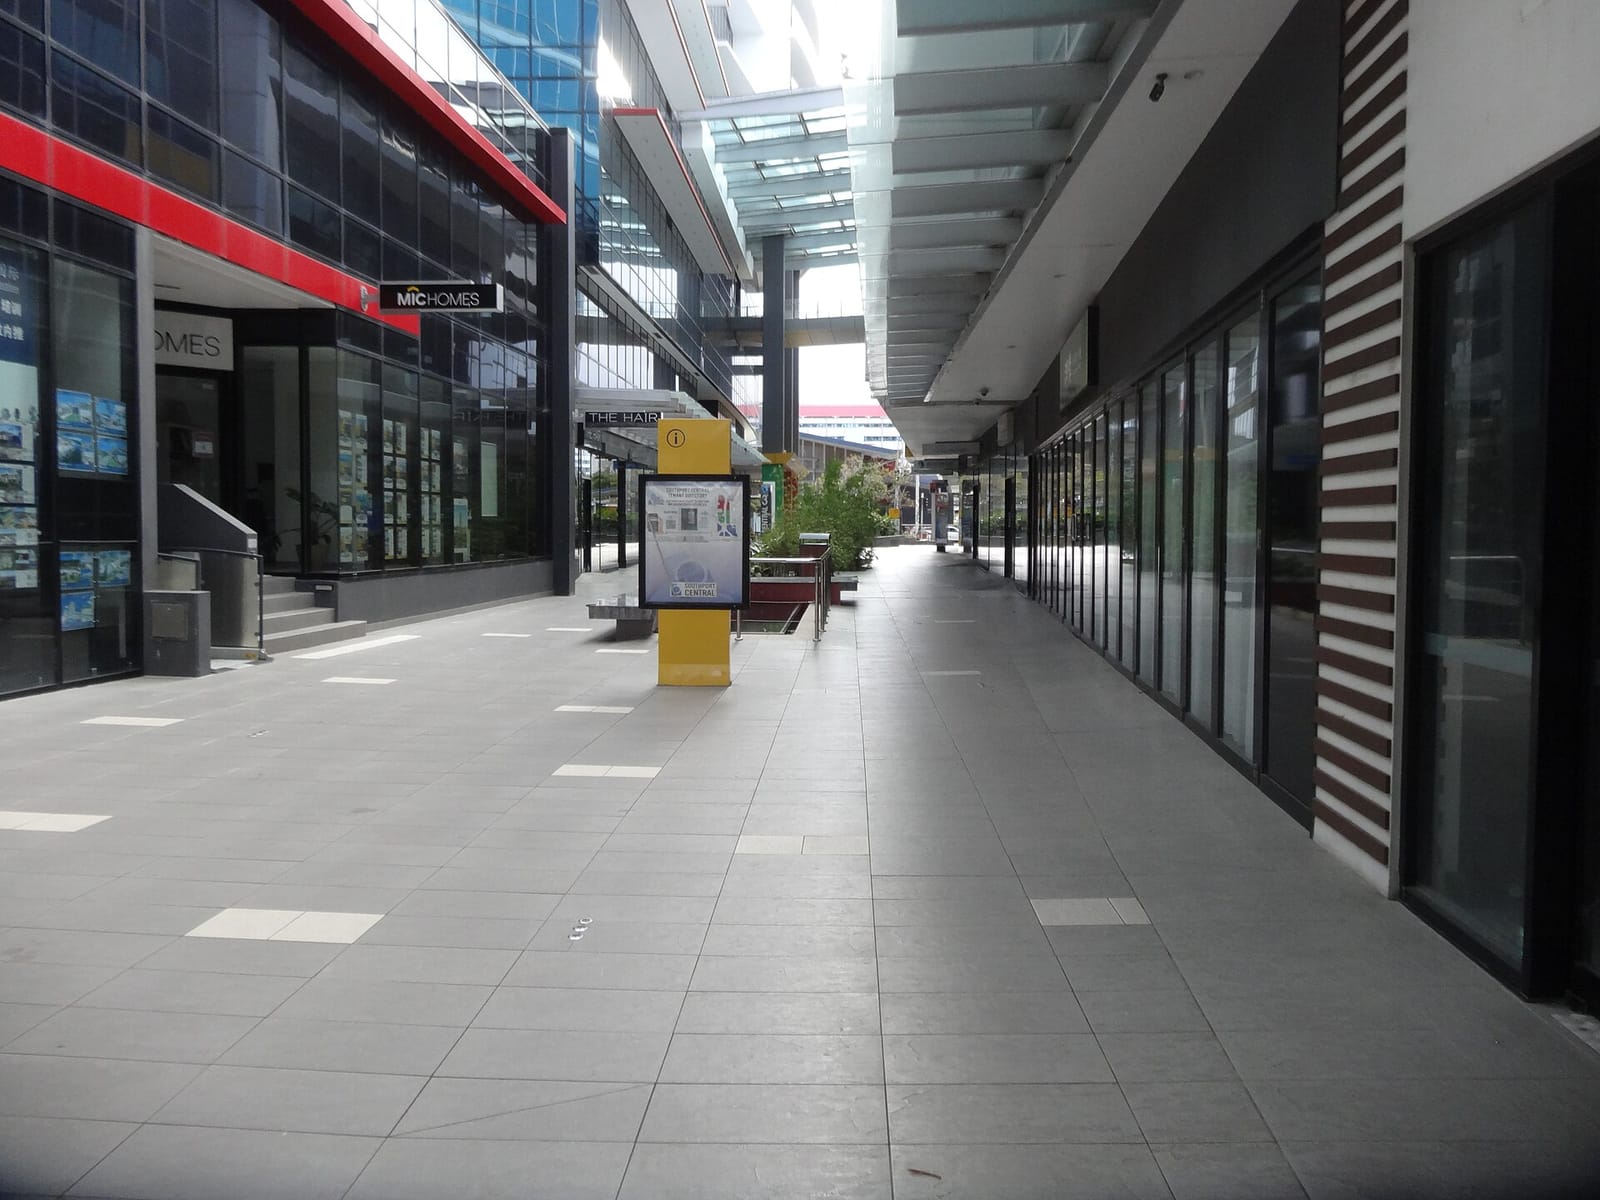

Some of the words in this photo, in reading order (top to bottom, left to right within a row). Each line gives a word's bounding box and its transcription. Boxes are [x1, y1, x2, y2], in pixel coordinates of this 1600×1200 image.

[396, 291, 481, 307] MICHOMES
[588, 411, 617, 423] THE
[623, 411, 658, 423] HAIR
[684, 589, 716, 597] CENTRAL
